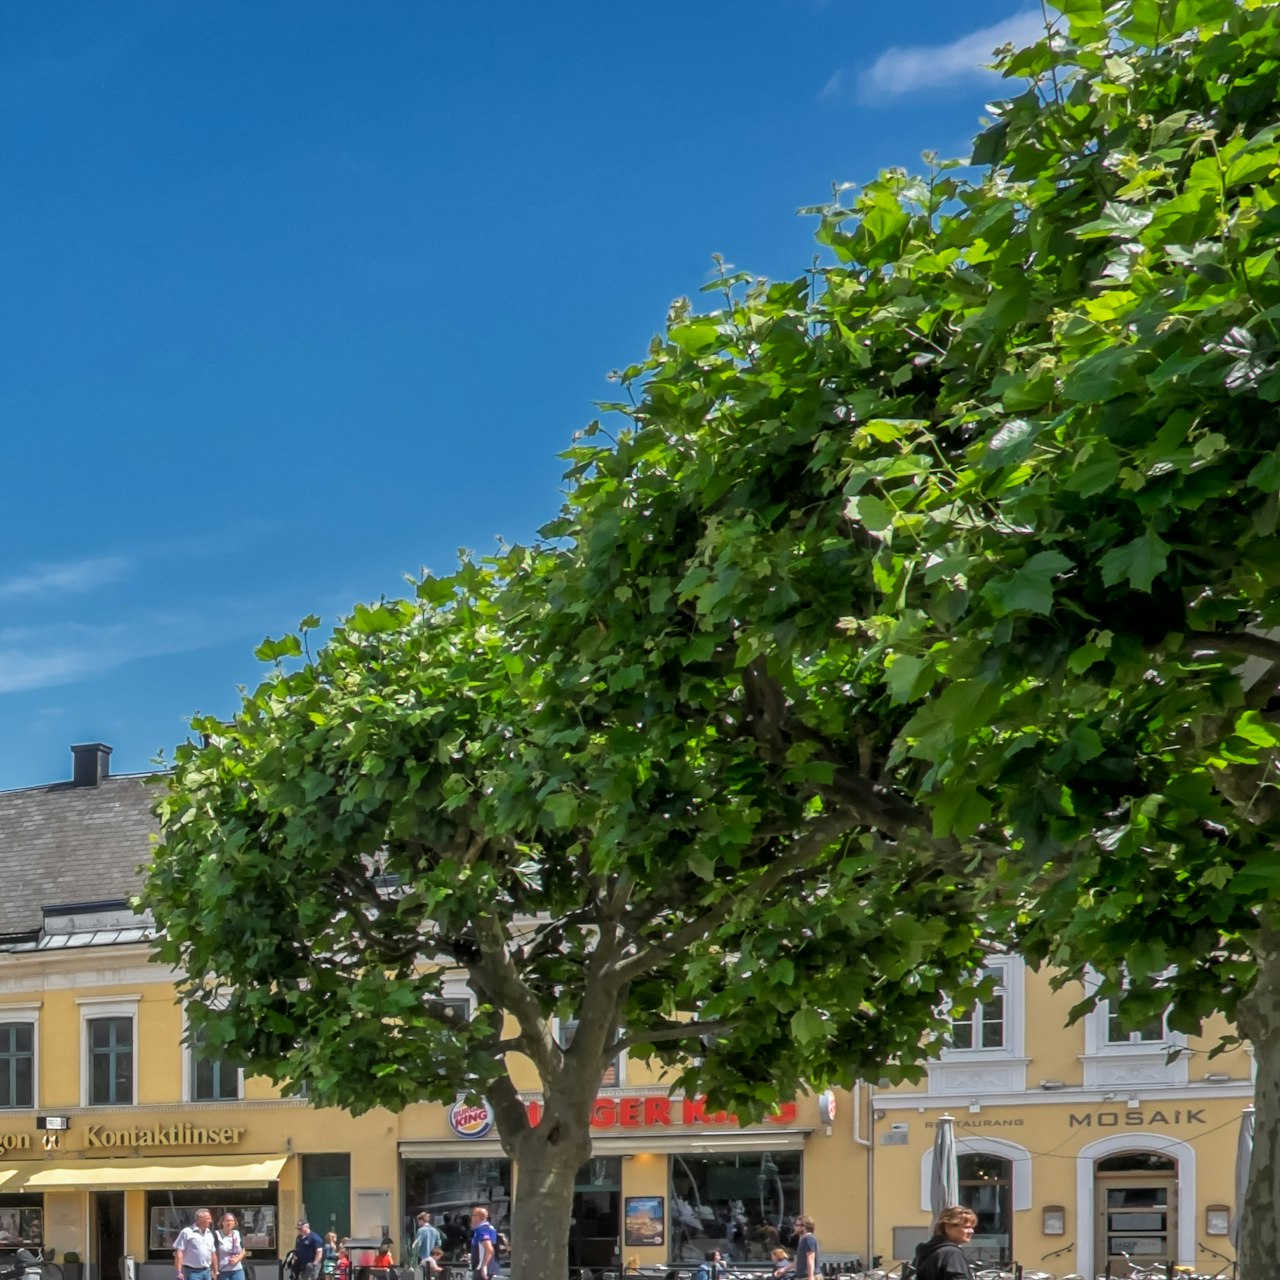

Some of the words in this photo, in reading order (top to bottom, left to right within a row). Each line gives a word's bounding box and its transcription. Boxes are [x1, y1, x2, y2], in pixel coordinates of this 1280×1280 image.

[455, 1109, 488, 1129] KING
[924, 1118, 1025, 1129] RTAURANG
[1069, 1109, 1207, 1128] MOSAIK
[82, 1122, 245, 1149] Kontaktlinser
